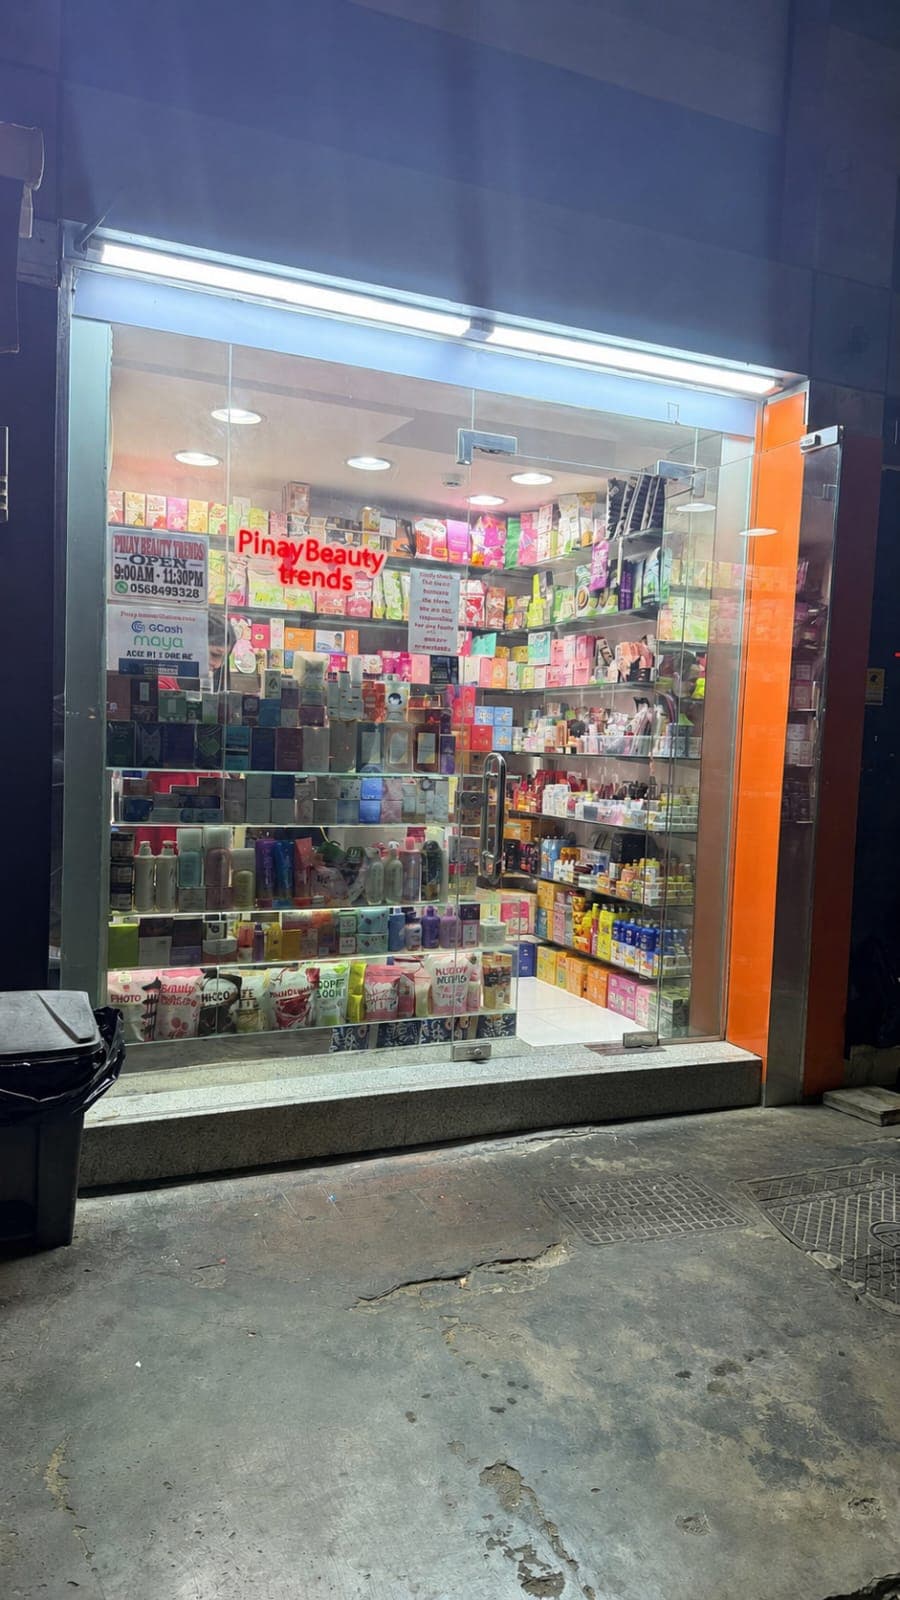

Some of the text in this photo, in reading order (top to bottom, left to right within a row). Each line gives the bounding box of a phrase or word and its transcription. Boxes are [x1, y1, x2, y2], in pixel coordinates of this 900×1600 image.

[114, 535, 204, 560] PINAY BEAUTY TRENDS
[129, 554, 188, 568] OPEN
[114, 563, 203, 587] 9:00AM 11:30PM
[278, 563, 353, 592] trends
[130, 583, 200, 598] 0568493328
[149, 623, 183, 634] GCash
[133, 635, 184, 650] maya
